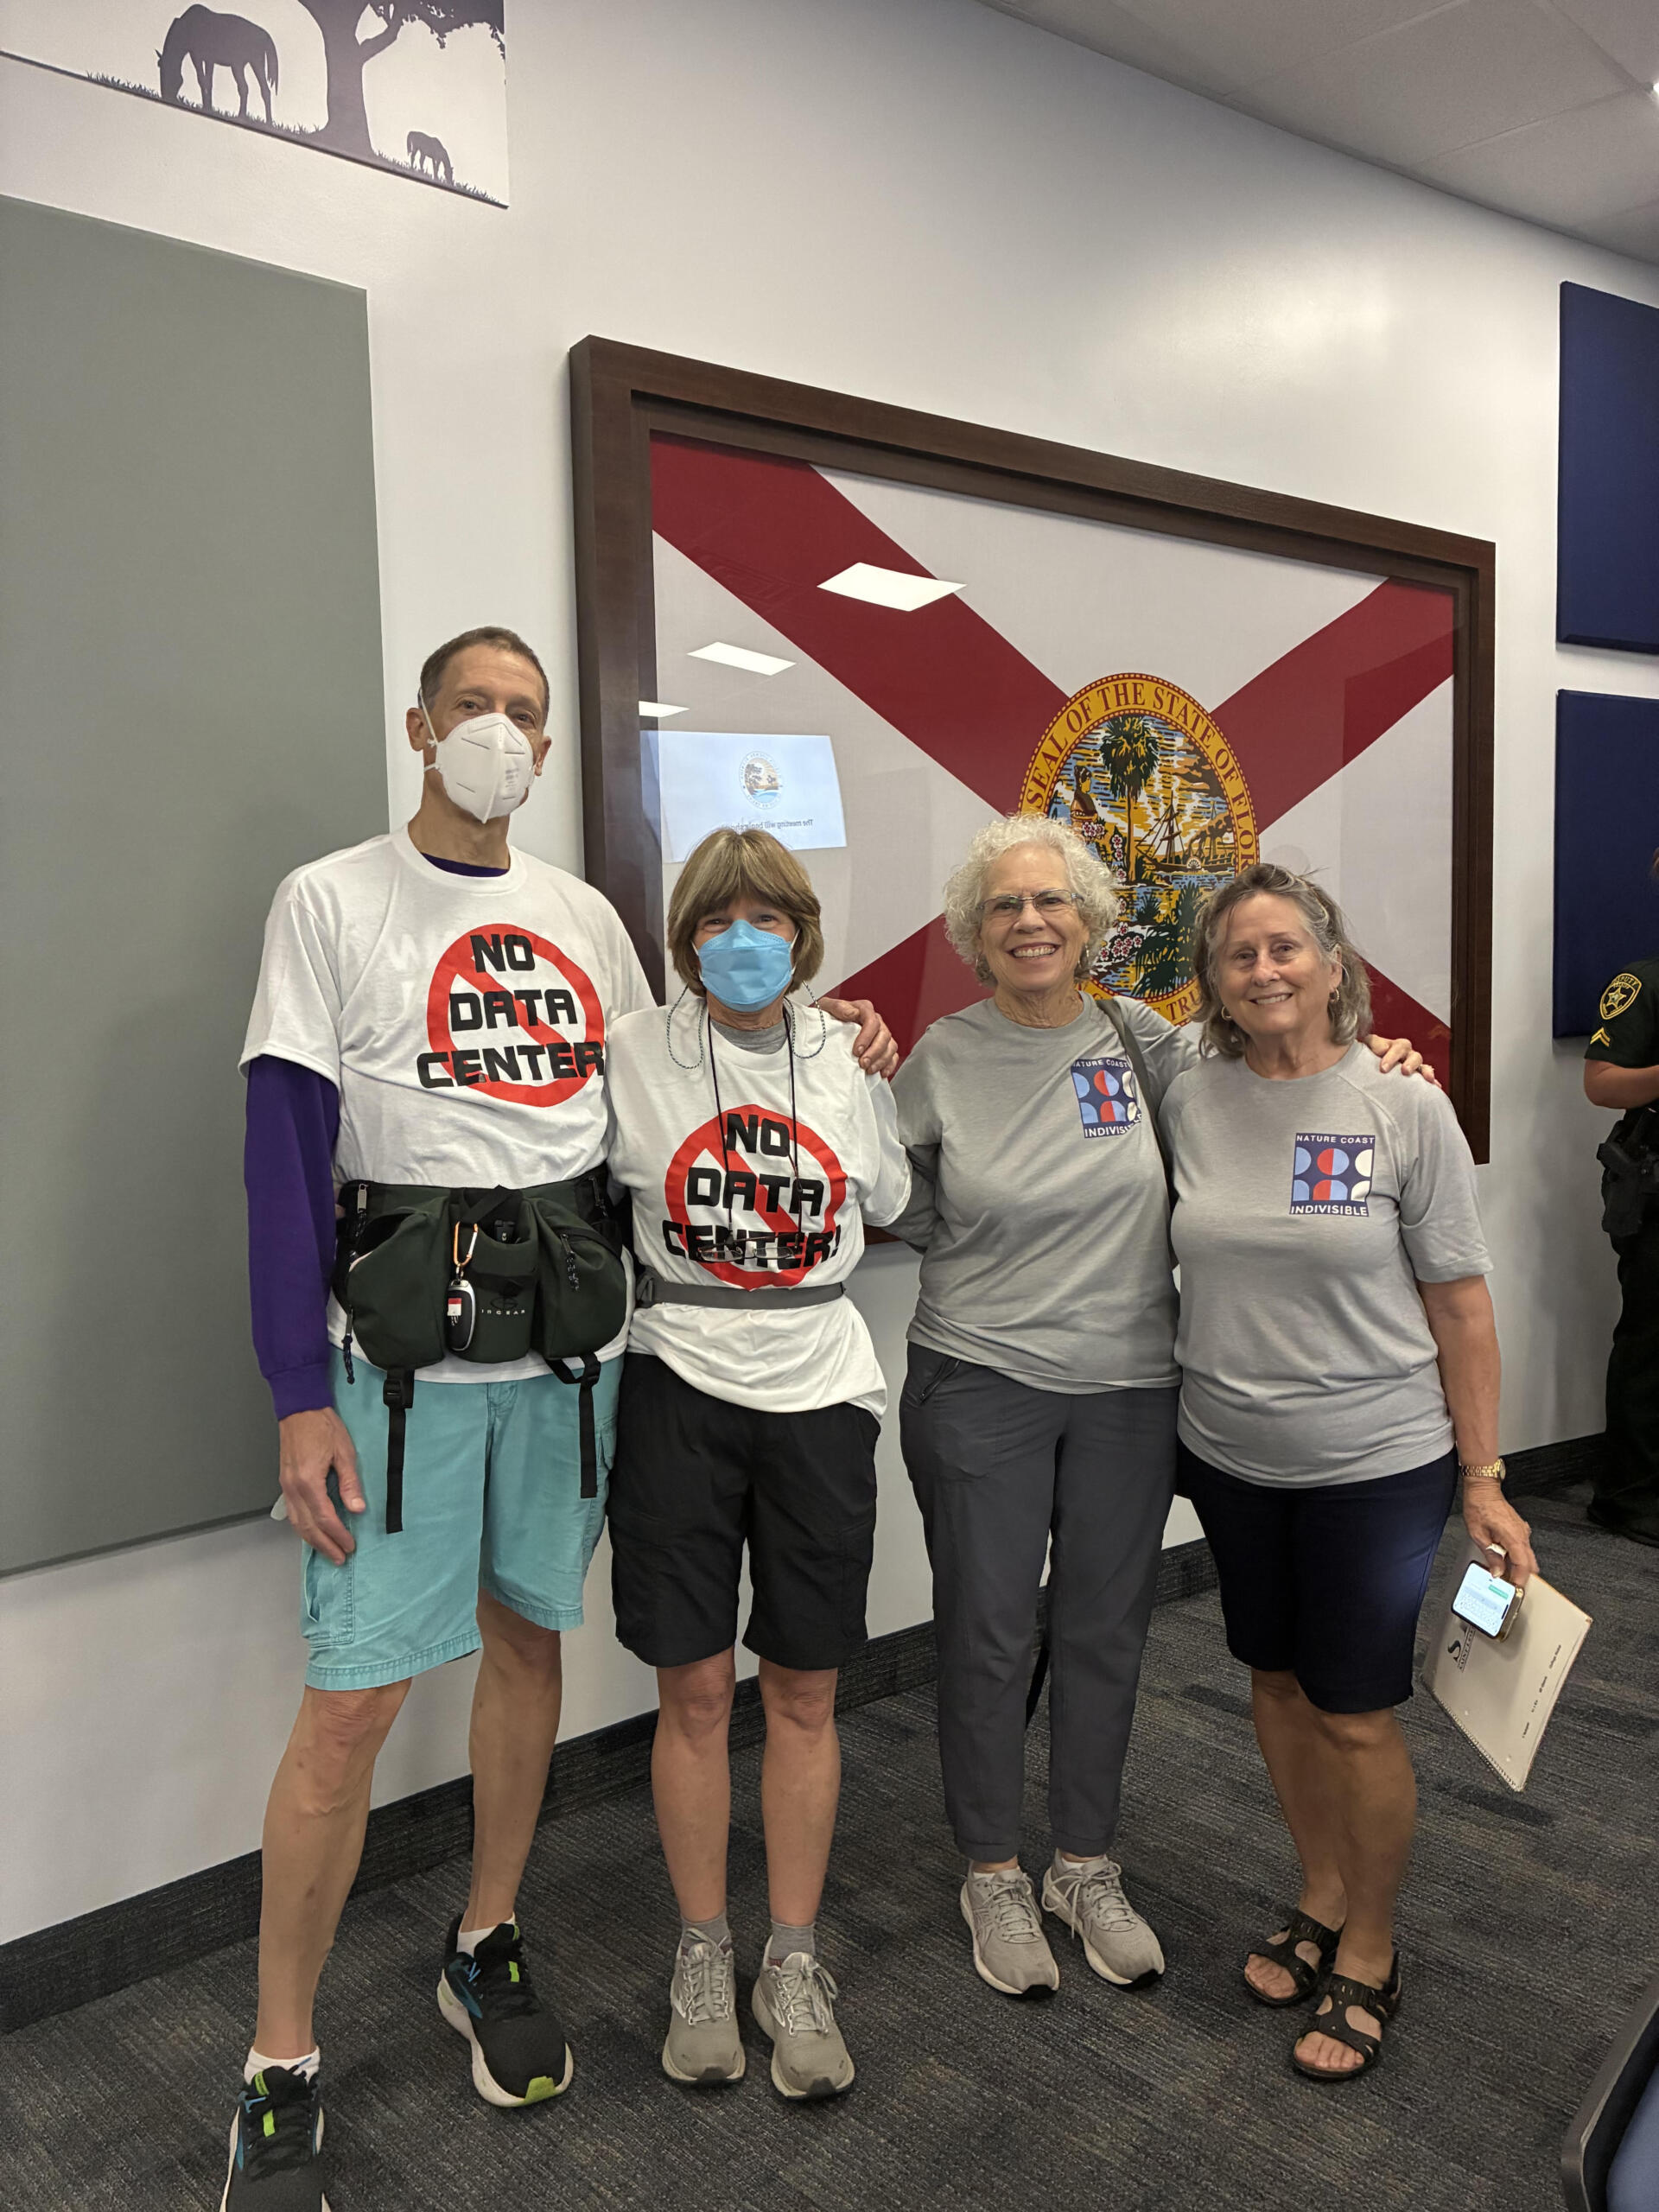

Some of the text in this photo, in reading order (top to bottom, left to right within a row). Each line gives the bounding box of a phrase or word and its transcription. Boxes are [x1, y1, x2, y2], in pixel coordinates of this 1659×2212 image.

[1026, 682, 1255, 872] SEAL OF THE STATE OF FLOR
[470, 933, 536, 973] NO
[449, 989, 578, 1032] DATA
[1166, 987, 1202, 1021] TRU
[416, 1041, 605, 1089] CENTER
[1106, 1058, 1128, 1068] COAST
[727, 1112, 791, 1158] NO
[1296, 1135, 1337, 1143] NATURE
[687, 1166, 825, 1217] DATA
[1291, 1205, 1369, 1216] INDIVISIBLE
